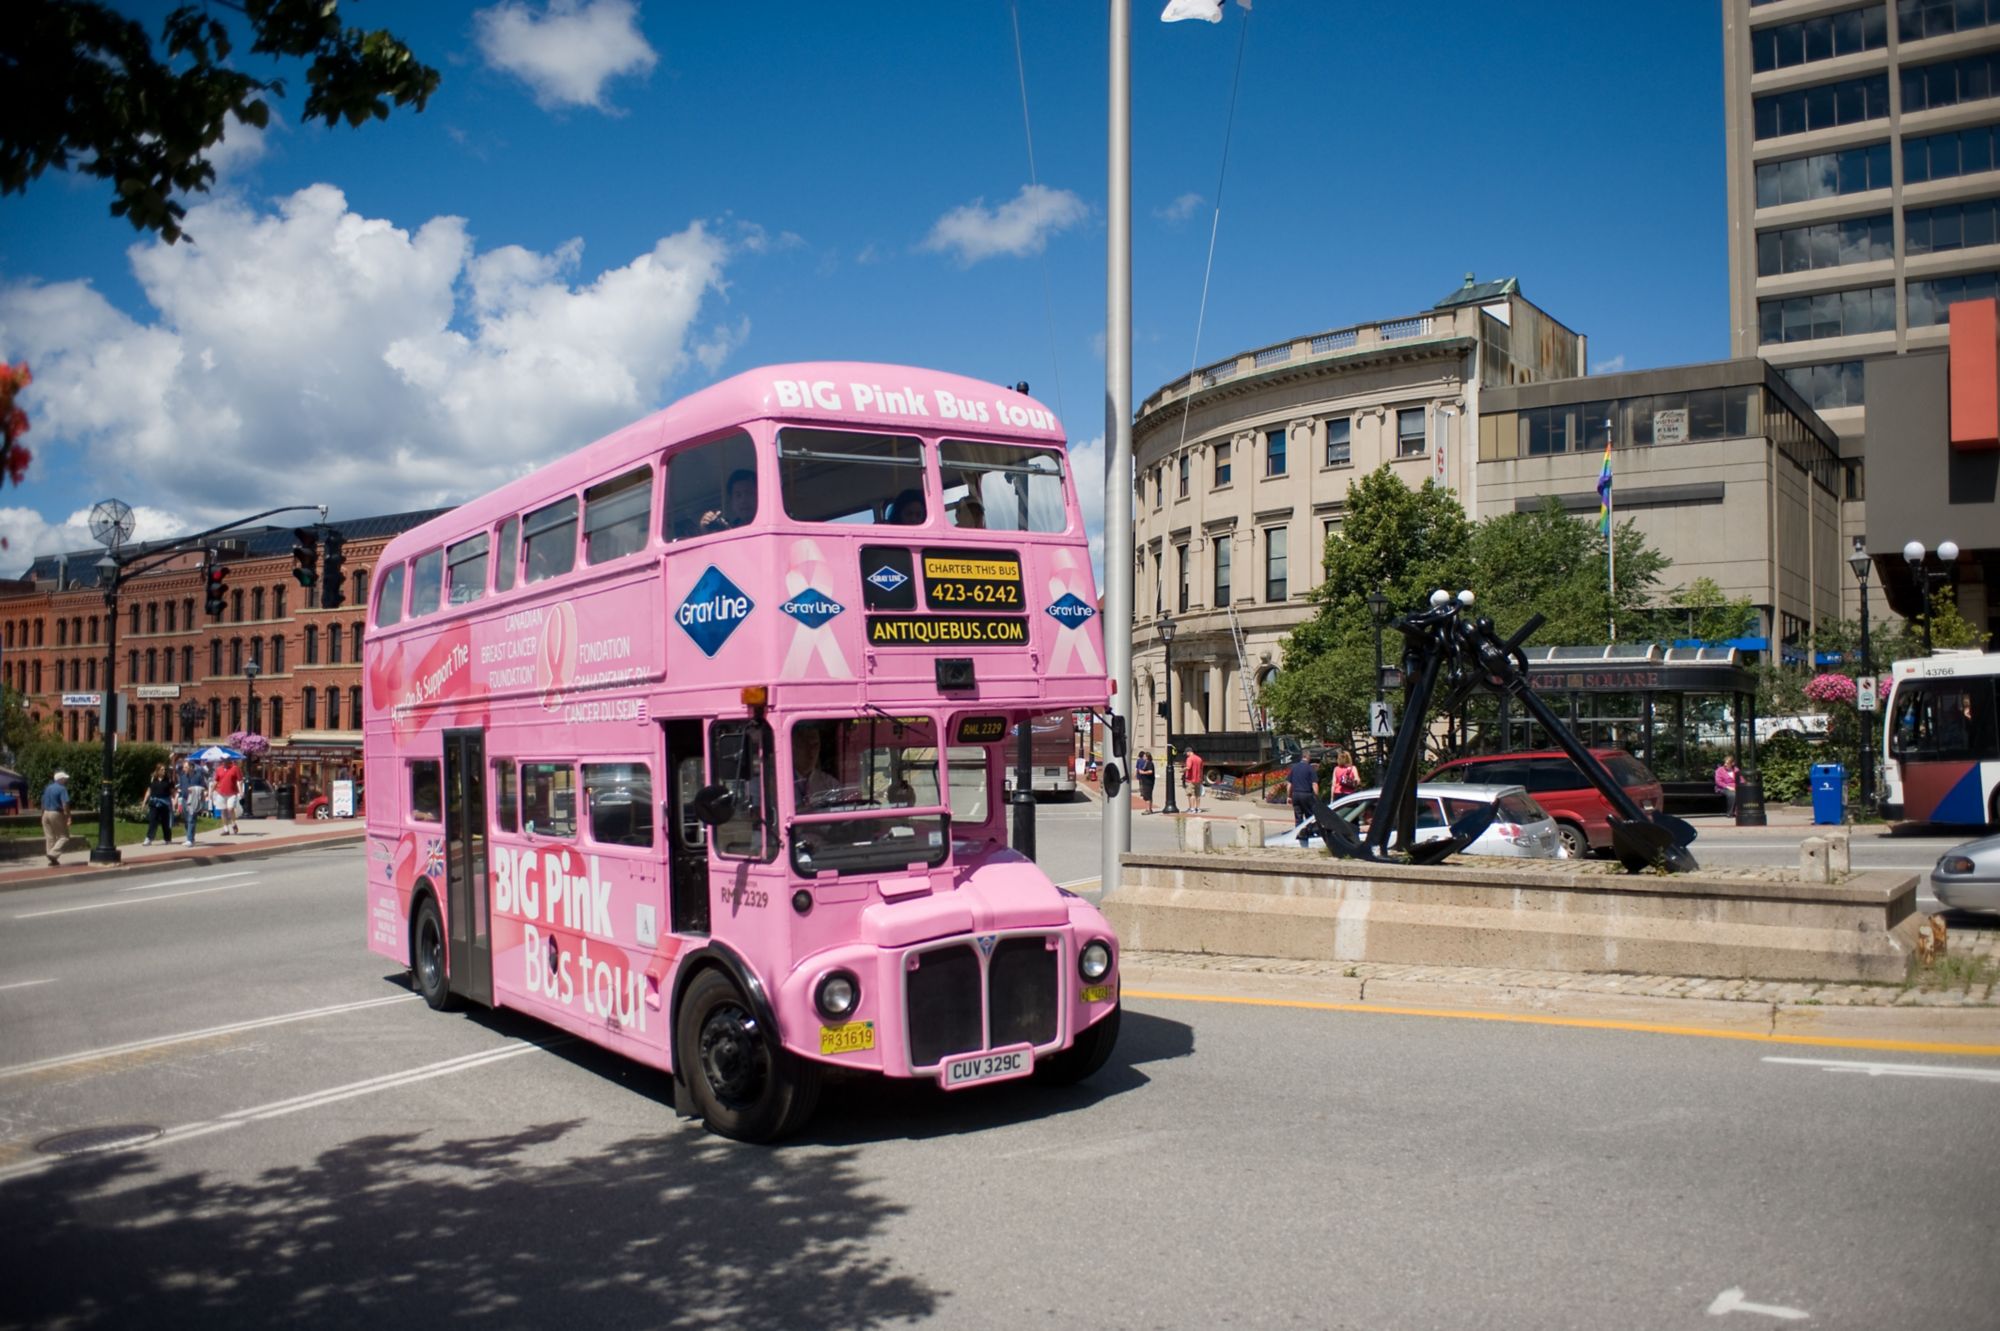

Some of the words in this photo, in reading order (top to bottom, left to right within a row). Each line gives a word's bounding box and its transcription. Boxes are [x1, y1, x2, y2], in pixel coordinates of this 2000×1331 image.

[773, 379, 842, 411] BIG
[850, 383, 930, 417] Pink
[934, 389, 990, 423] Bus
[996, 400, 1056, 432] tour
[928, 563, 973, 575] CHARTER
[976, 565, 996, 576] THIS
[1000, 566, 1017, 576] BUS
[932, 583, 1018, 603] 423-6242
[873, 621, 1024, 643] ANTIQUEBUS.COM
[481, 640, 507, 665] BREAST
[507, 636, 538, 661] CANCER
[578, 635, 631, 665] FONDATION
[423, 653, 453, 699] Support
[453, 643, 469, 672] The
[1586, 672, 1659, 688] SQUARE
[1925, 667, 1954, 677] 43766
[495, 846, 540, 920] BIG
[545, 850, 615, 938] Pink
[743, 890, 769, 908] 2329
[524, 923, 574, 1005] Bus
[578, 938, 647, 1033] tour
[953, 1059, 981, 1079] CUV
[984, 1053, 1021, 1074] 329C
